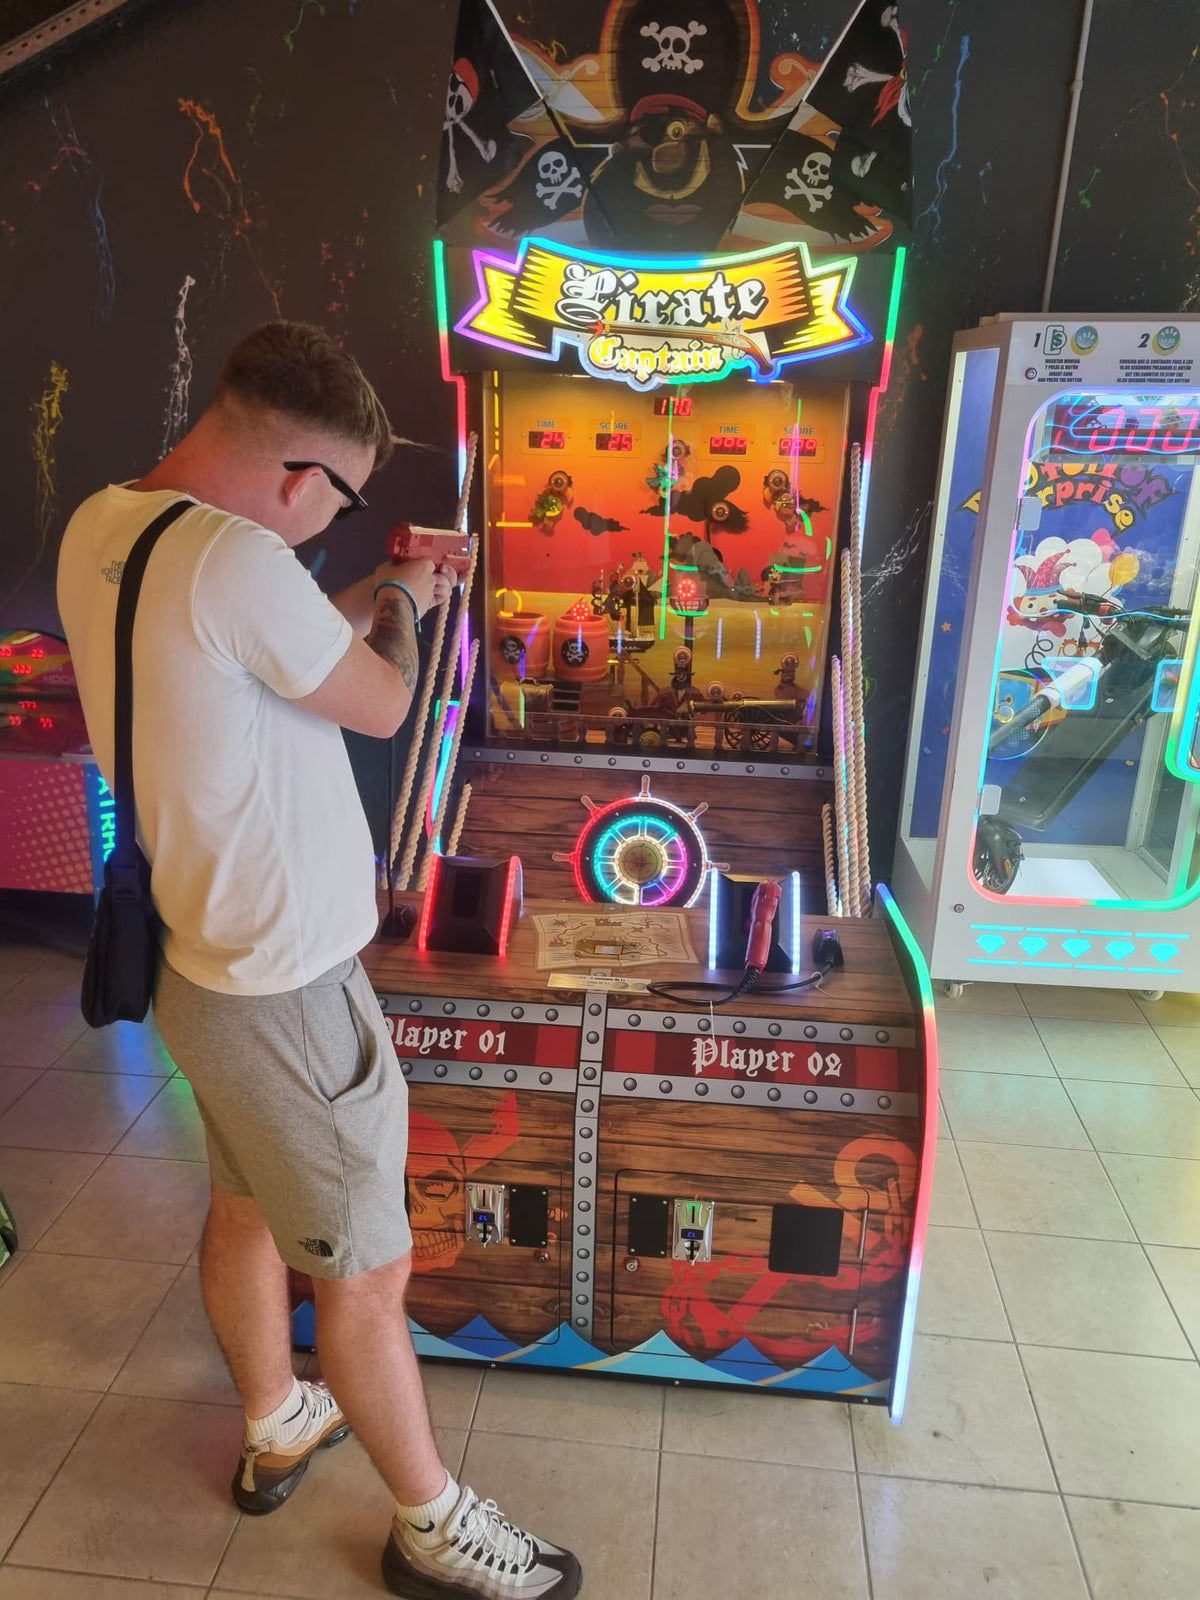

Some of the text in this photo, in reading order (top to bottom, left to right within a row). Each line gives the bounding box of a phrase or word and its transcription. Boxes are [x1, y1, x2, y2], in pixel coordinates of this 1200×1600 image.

[556, 263, 769, 329] Pirate
[1033, 332, 1042, 348] 1
[1137, 333, 1151, 348] 2
[589, 335, 724, 382] Captain
[536, 420, 557, 429] TIME
[599, 422, 630, 431] SCORE
[718, 426, 739, 434] TIME
[783, 427, 815, 435] SCORE
[540, 431, 565, 449] 24
[607, 433, 633, 451] 25
[478, 1029, 507, 1056] 01
[691, 1037, 843, 1078] Player 02
